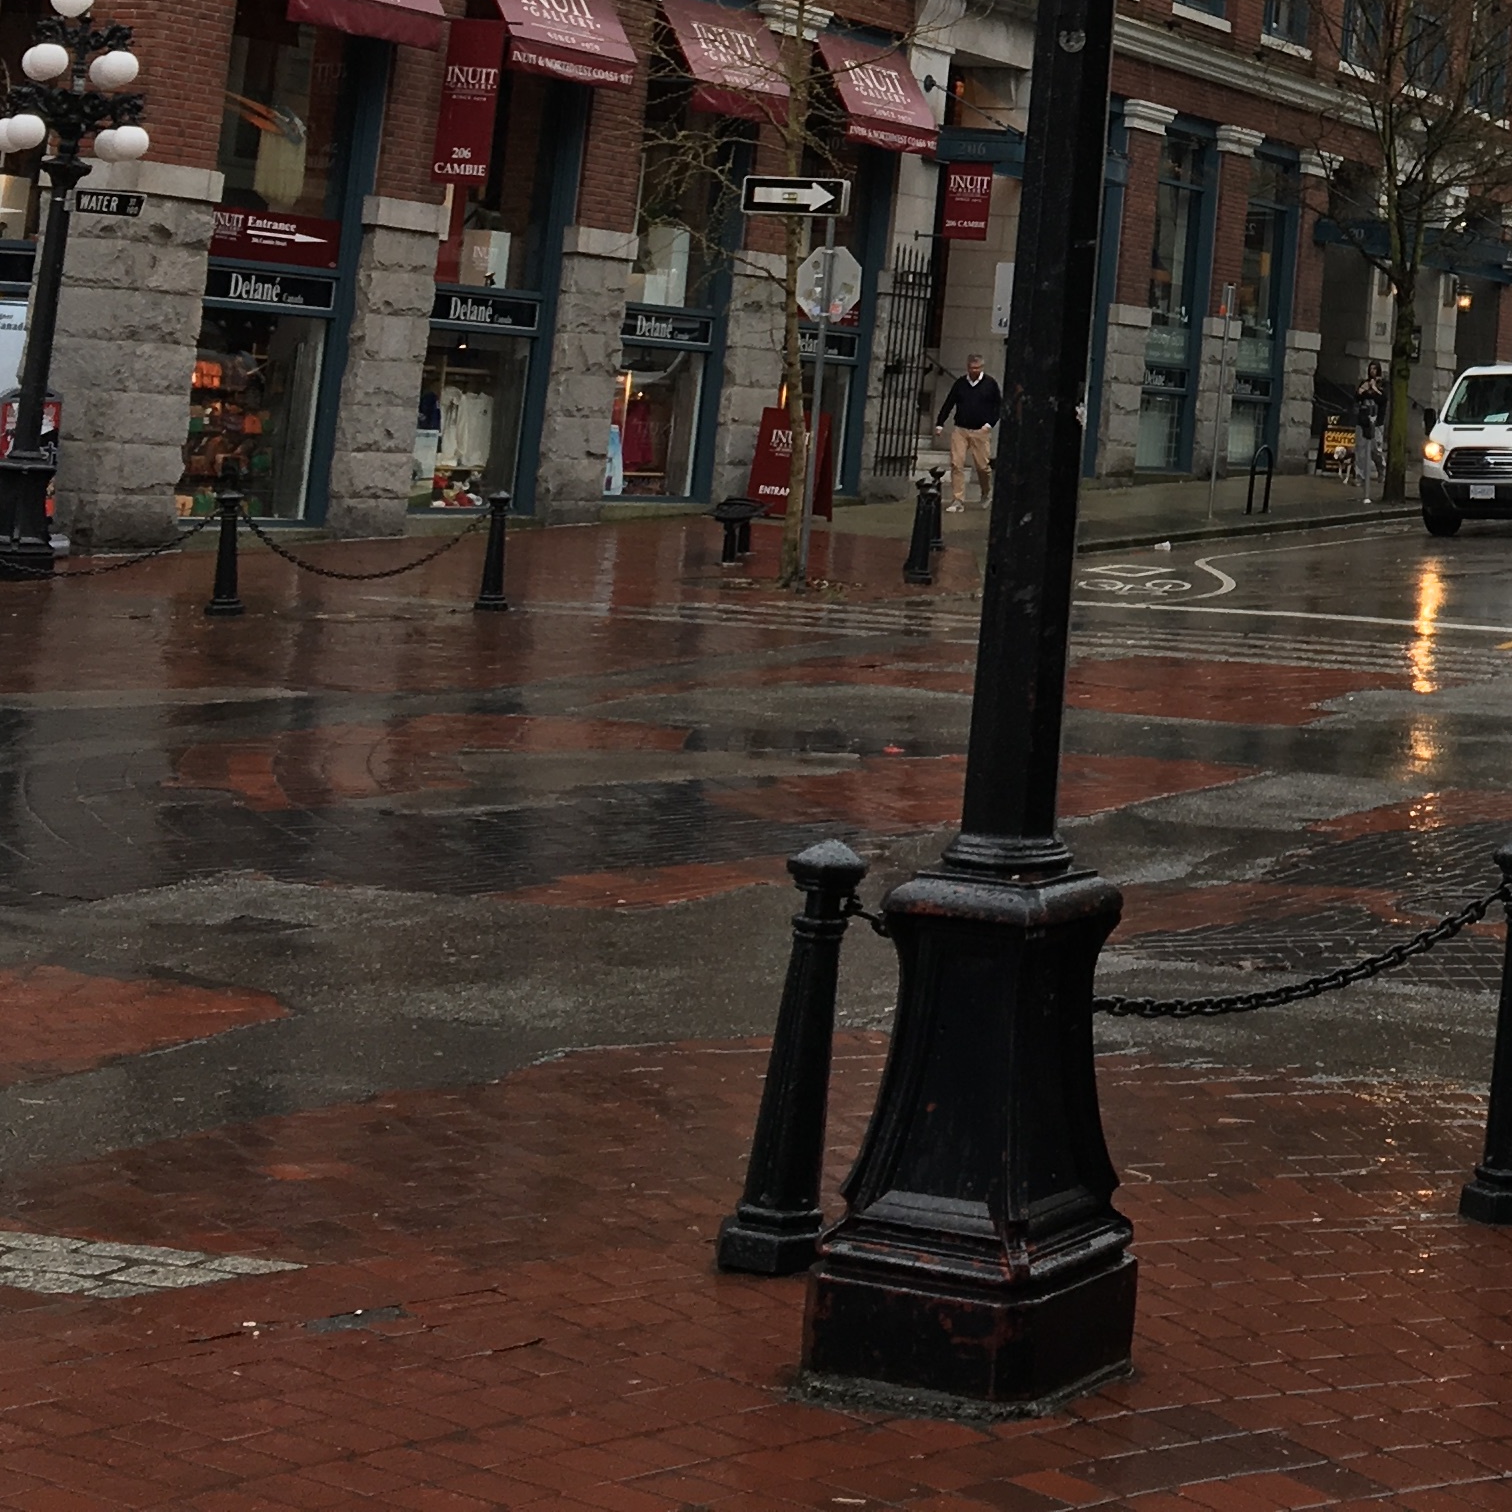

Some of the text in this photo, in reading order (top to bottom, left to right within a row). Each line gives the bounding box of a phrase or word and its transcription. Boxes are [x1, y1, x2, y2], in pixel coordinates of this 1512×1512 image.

[530, 7, 594, 29] GALLERY
[447, 66, 498, 84] INUIT
[844, 60, 905, 95] INUIT
[859, 86, 907, 104] GALLERY
[451, 147, 472, 159] 206
[958, 142, 986, 155] 206
[434, 162, 486, 176] CAMBIE
[950, 175, 990, 189] INUIT
[80, 194, 119, 212] WATER
[213, 211, 297, 232] INUIT Entrance
[958, 220, 985, 228] CAMBIE
[228, 273, 280, 302] Delané
[449, 297, 493, 322] Delané
[636, 315, 673, 339] Delané
[1326, 436, 1355, 444] CAUTIO
[759, 485, 790, 496] ENTRAN
